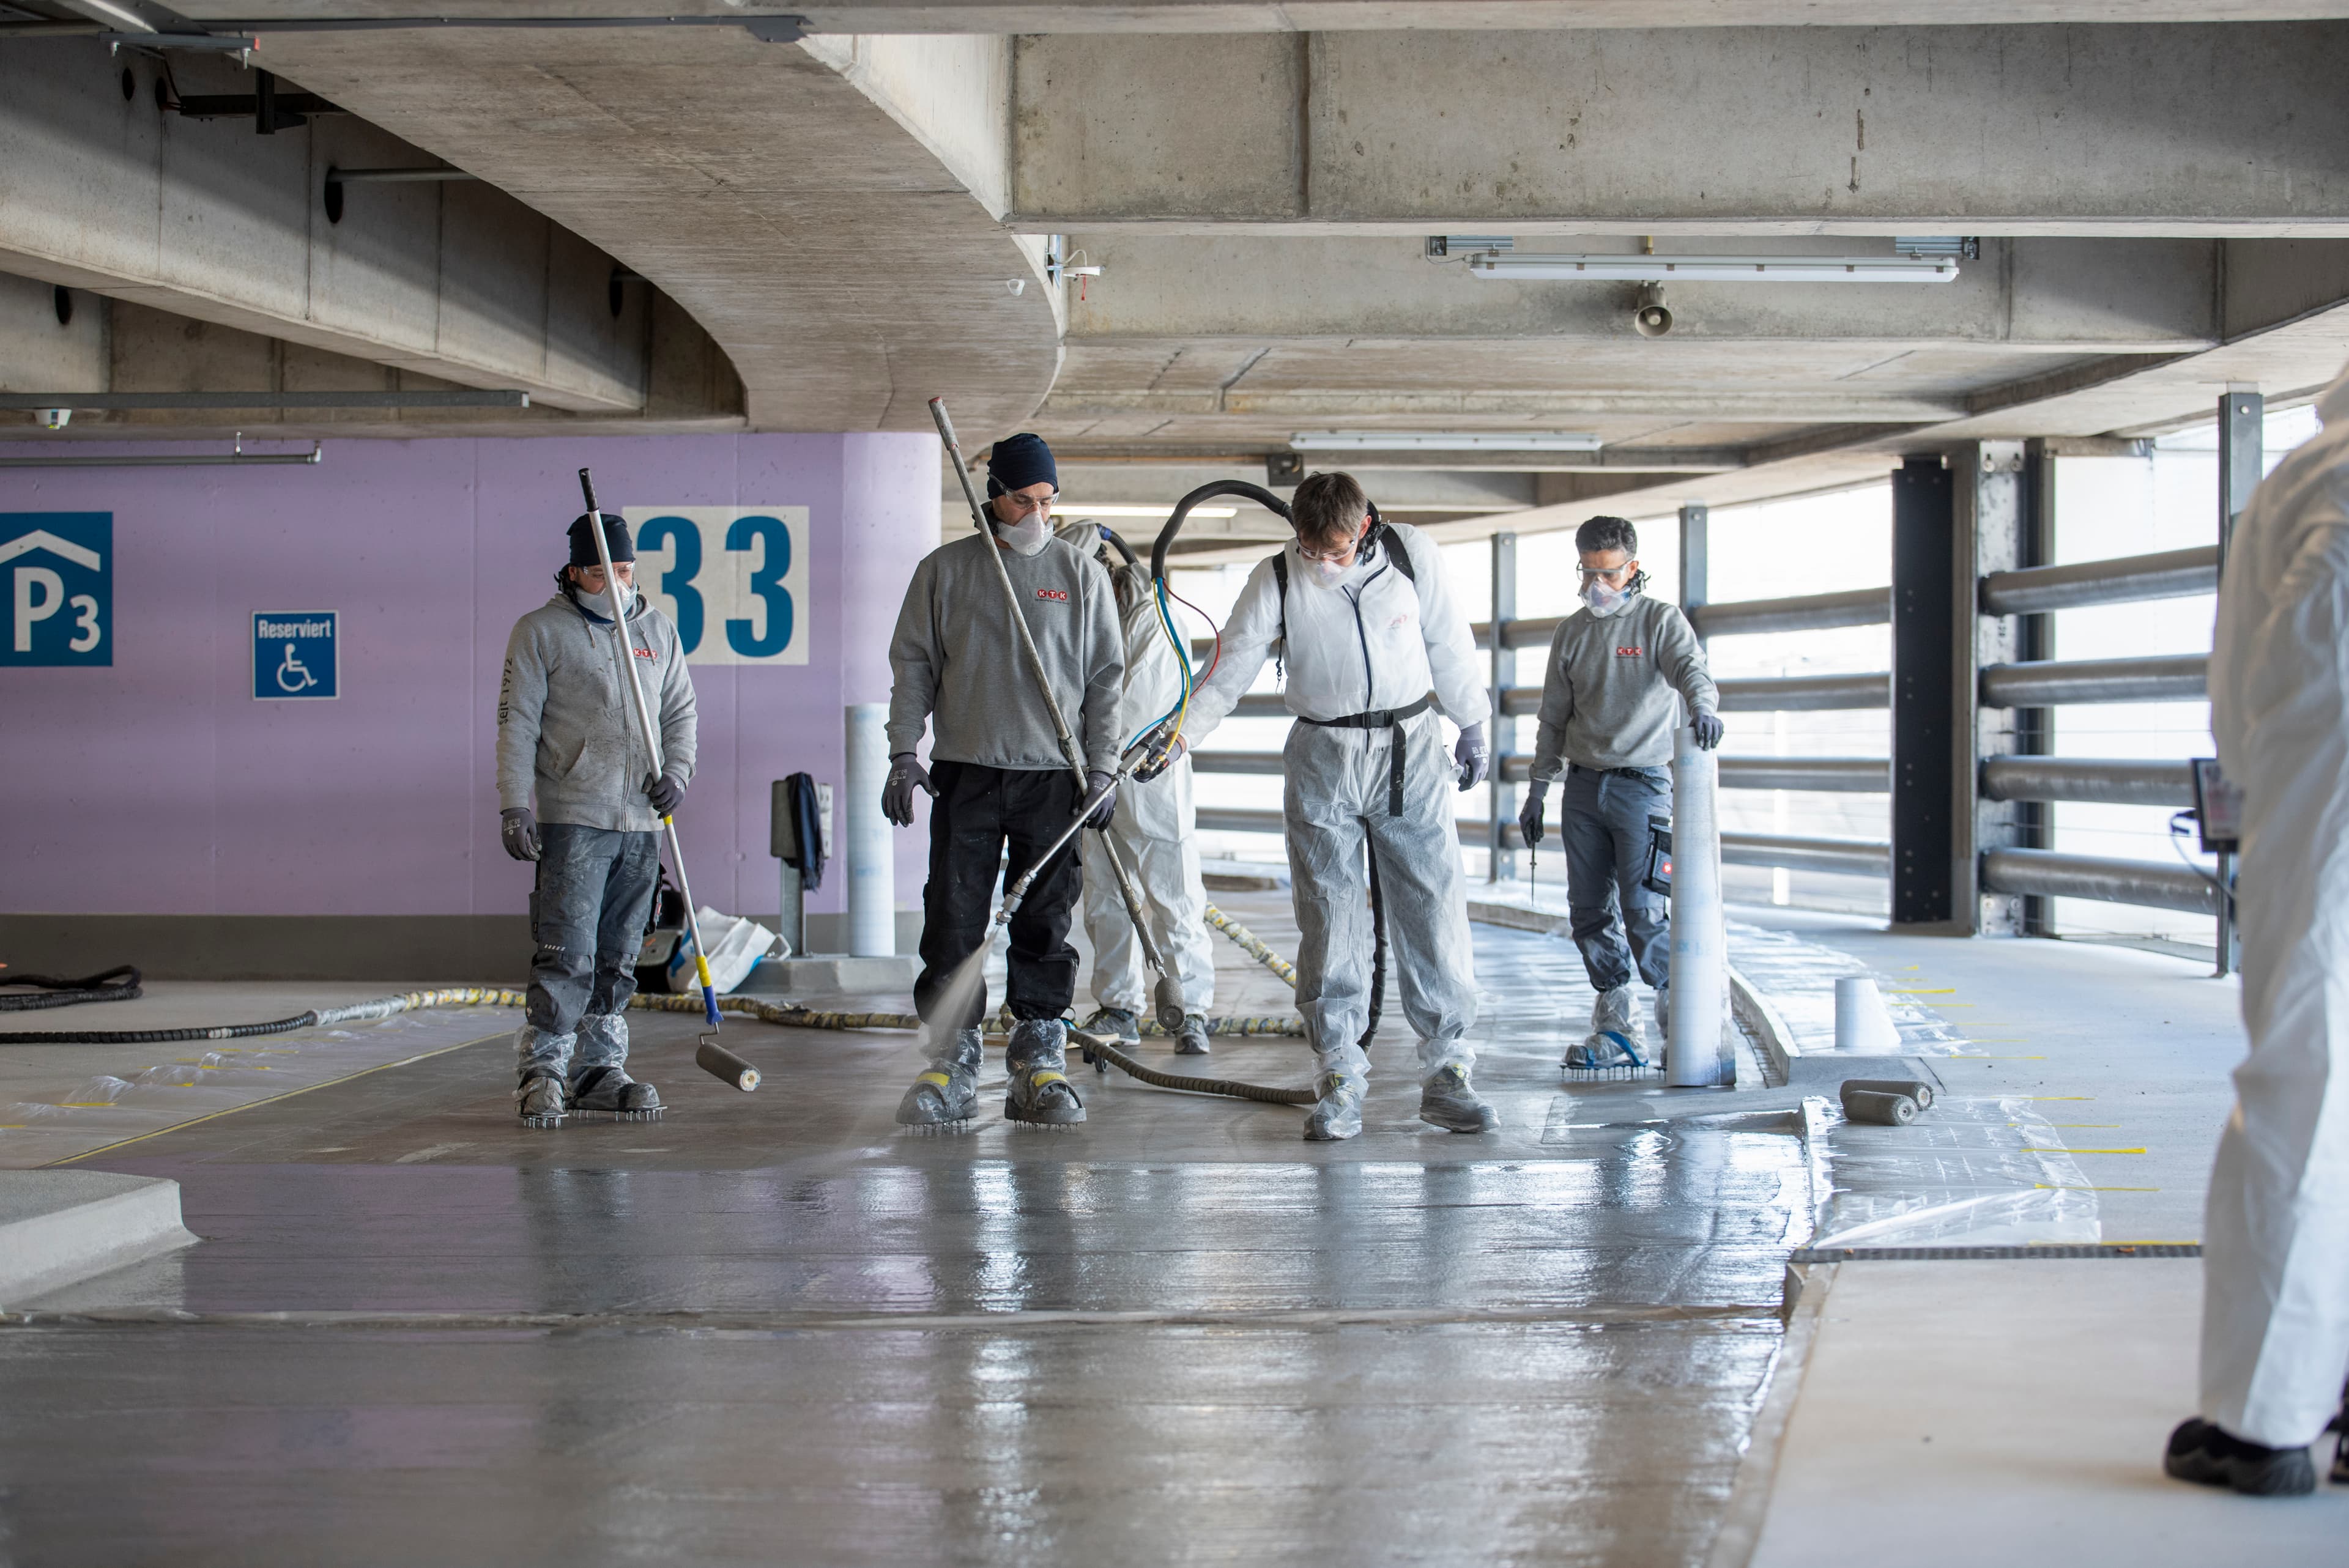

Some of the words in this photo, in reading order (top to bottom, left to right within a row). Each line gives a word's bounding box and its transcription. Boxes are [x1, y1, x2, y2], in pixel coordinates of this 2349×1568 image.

[637, 516, 793, 657] 33
[258, 618, 332, 638] Reserviert
[501, 657, 513, 695] 1972
[499, 701, 509, 725] seit
